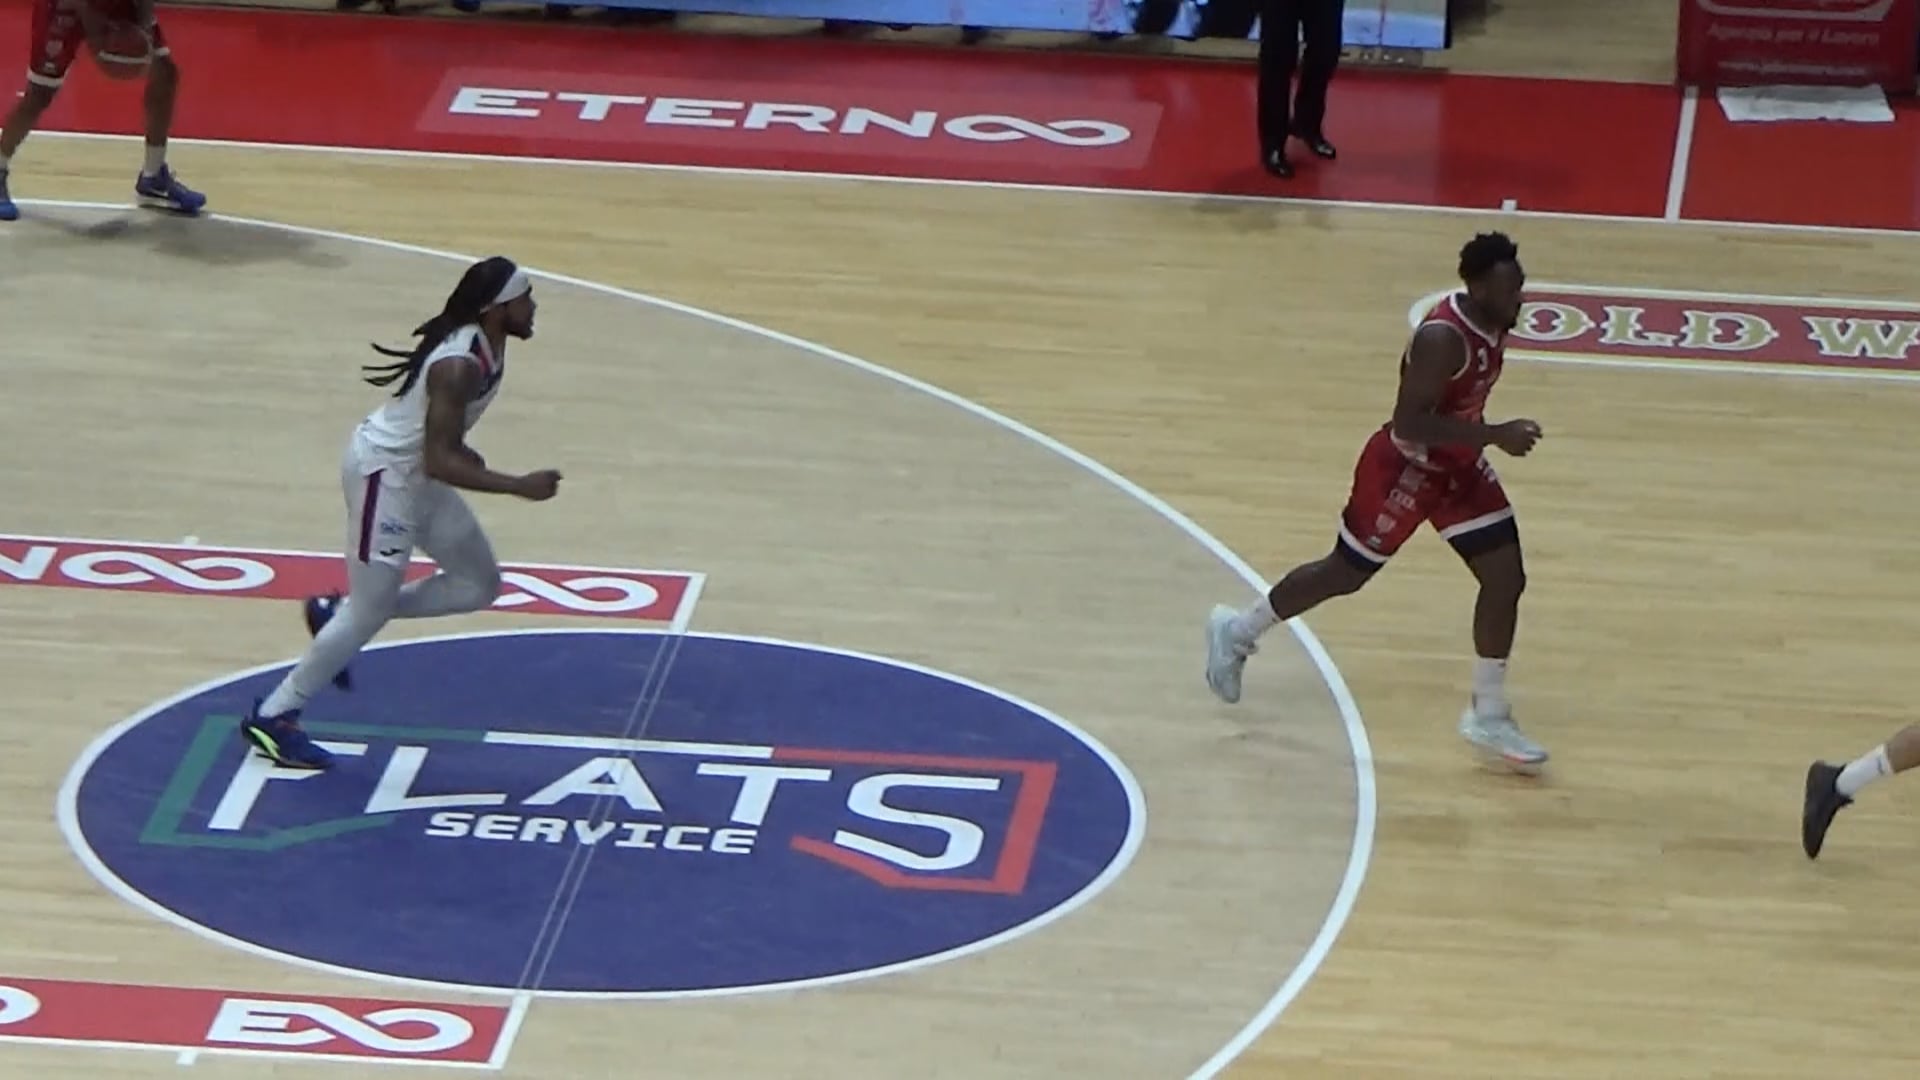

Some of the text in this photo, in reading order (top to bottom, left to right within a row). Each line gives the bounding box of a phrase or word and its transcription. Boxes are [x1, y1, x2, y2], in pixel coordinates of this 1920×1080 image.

[1507, 301, 1779, 351] OLD
[208, 738, 1002, 871] FLATS
[424, 811, 758, 855] SERVICE
